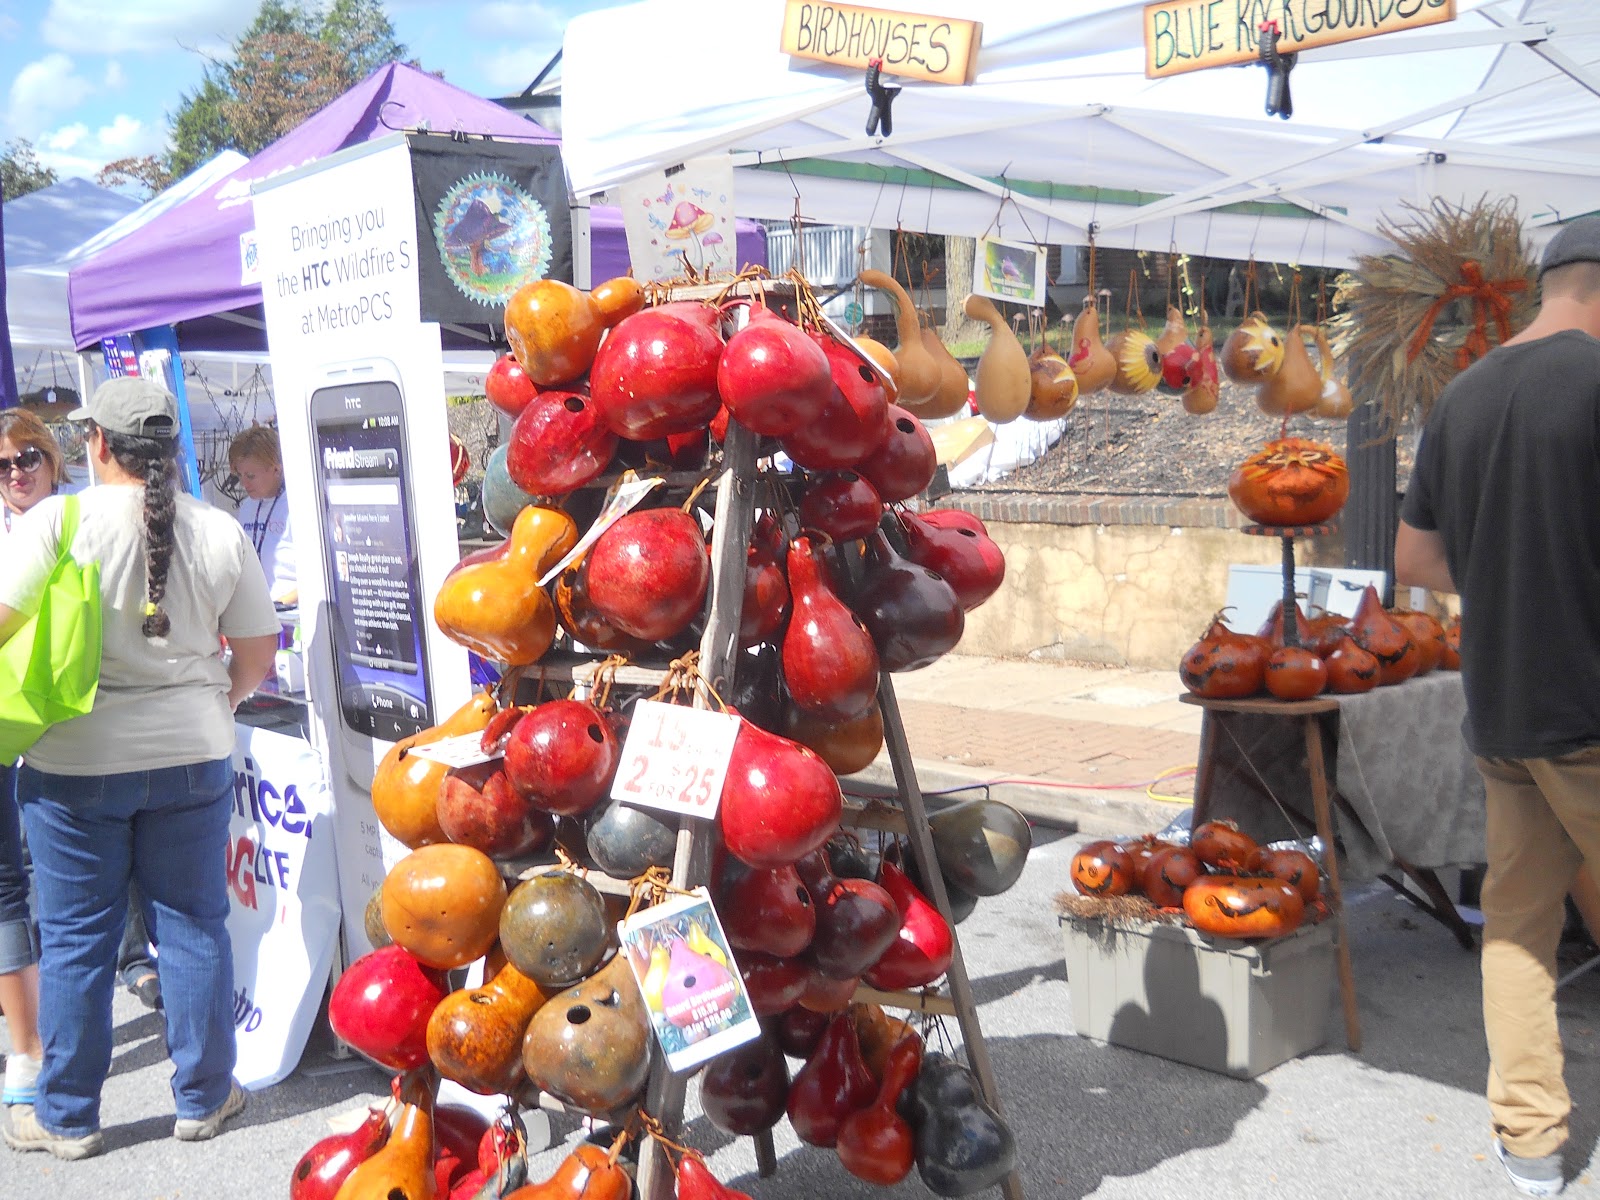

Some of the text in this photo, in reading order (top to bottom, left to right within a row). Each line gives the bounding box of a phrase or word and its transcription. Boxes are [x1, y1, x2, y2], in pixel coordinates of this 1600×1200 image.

[798, 4, 951, 73] BIRDHOUSES
[1154, 1, 1224, 69] BLUE
[1236, 0, 1304, 51] ROK
[291, 207, 385, 252] Bringing you
[277, 240, 410, 298] the HTC Wildfire S
[301, 291, 393, 335] at MetroPCS
[376, 694, 393, 709] Phone
[623, 754, 649, 793] 2
